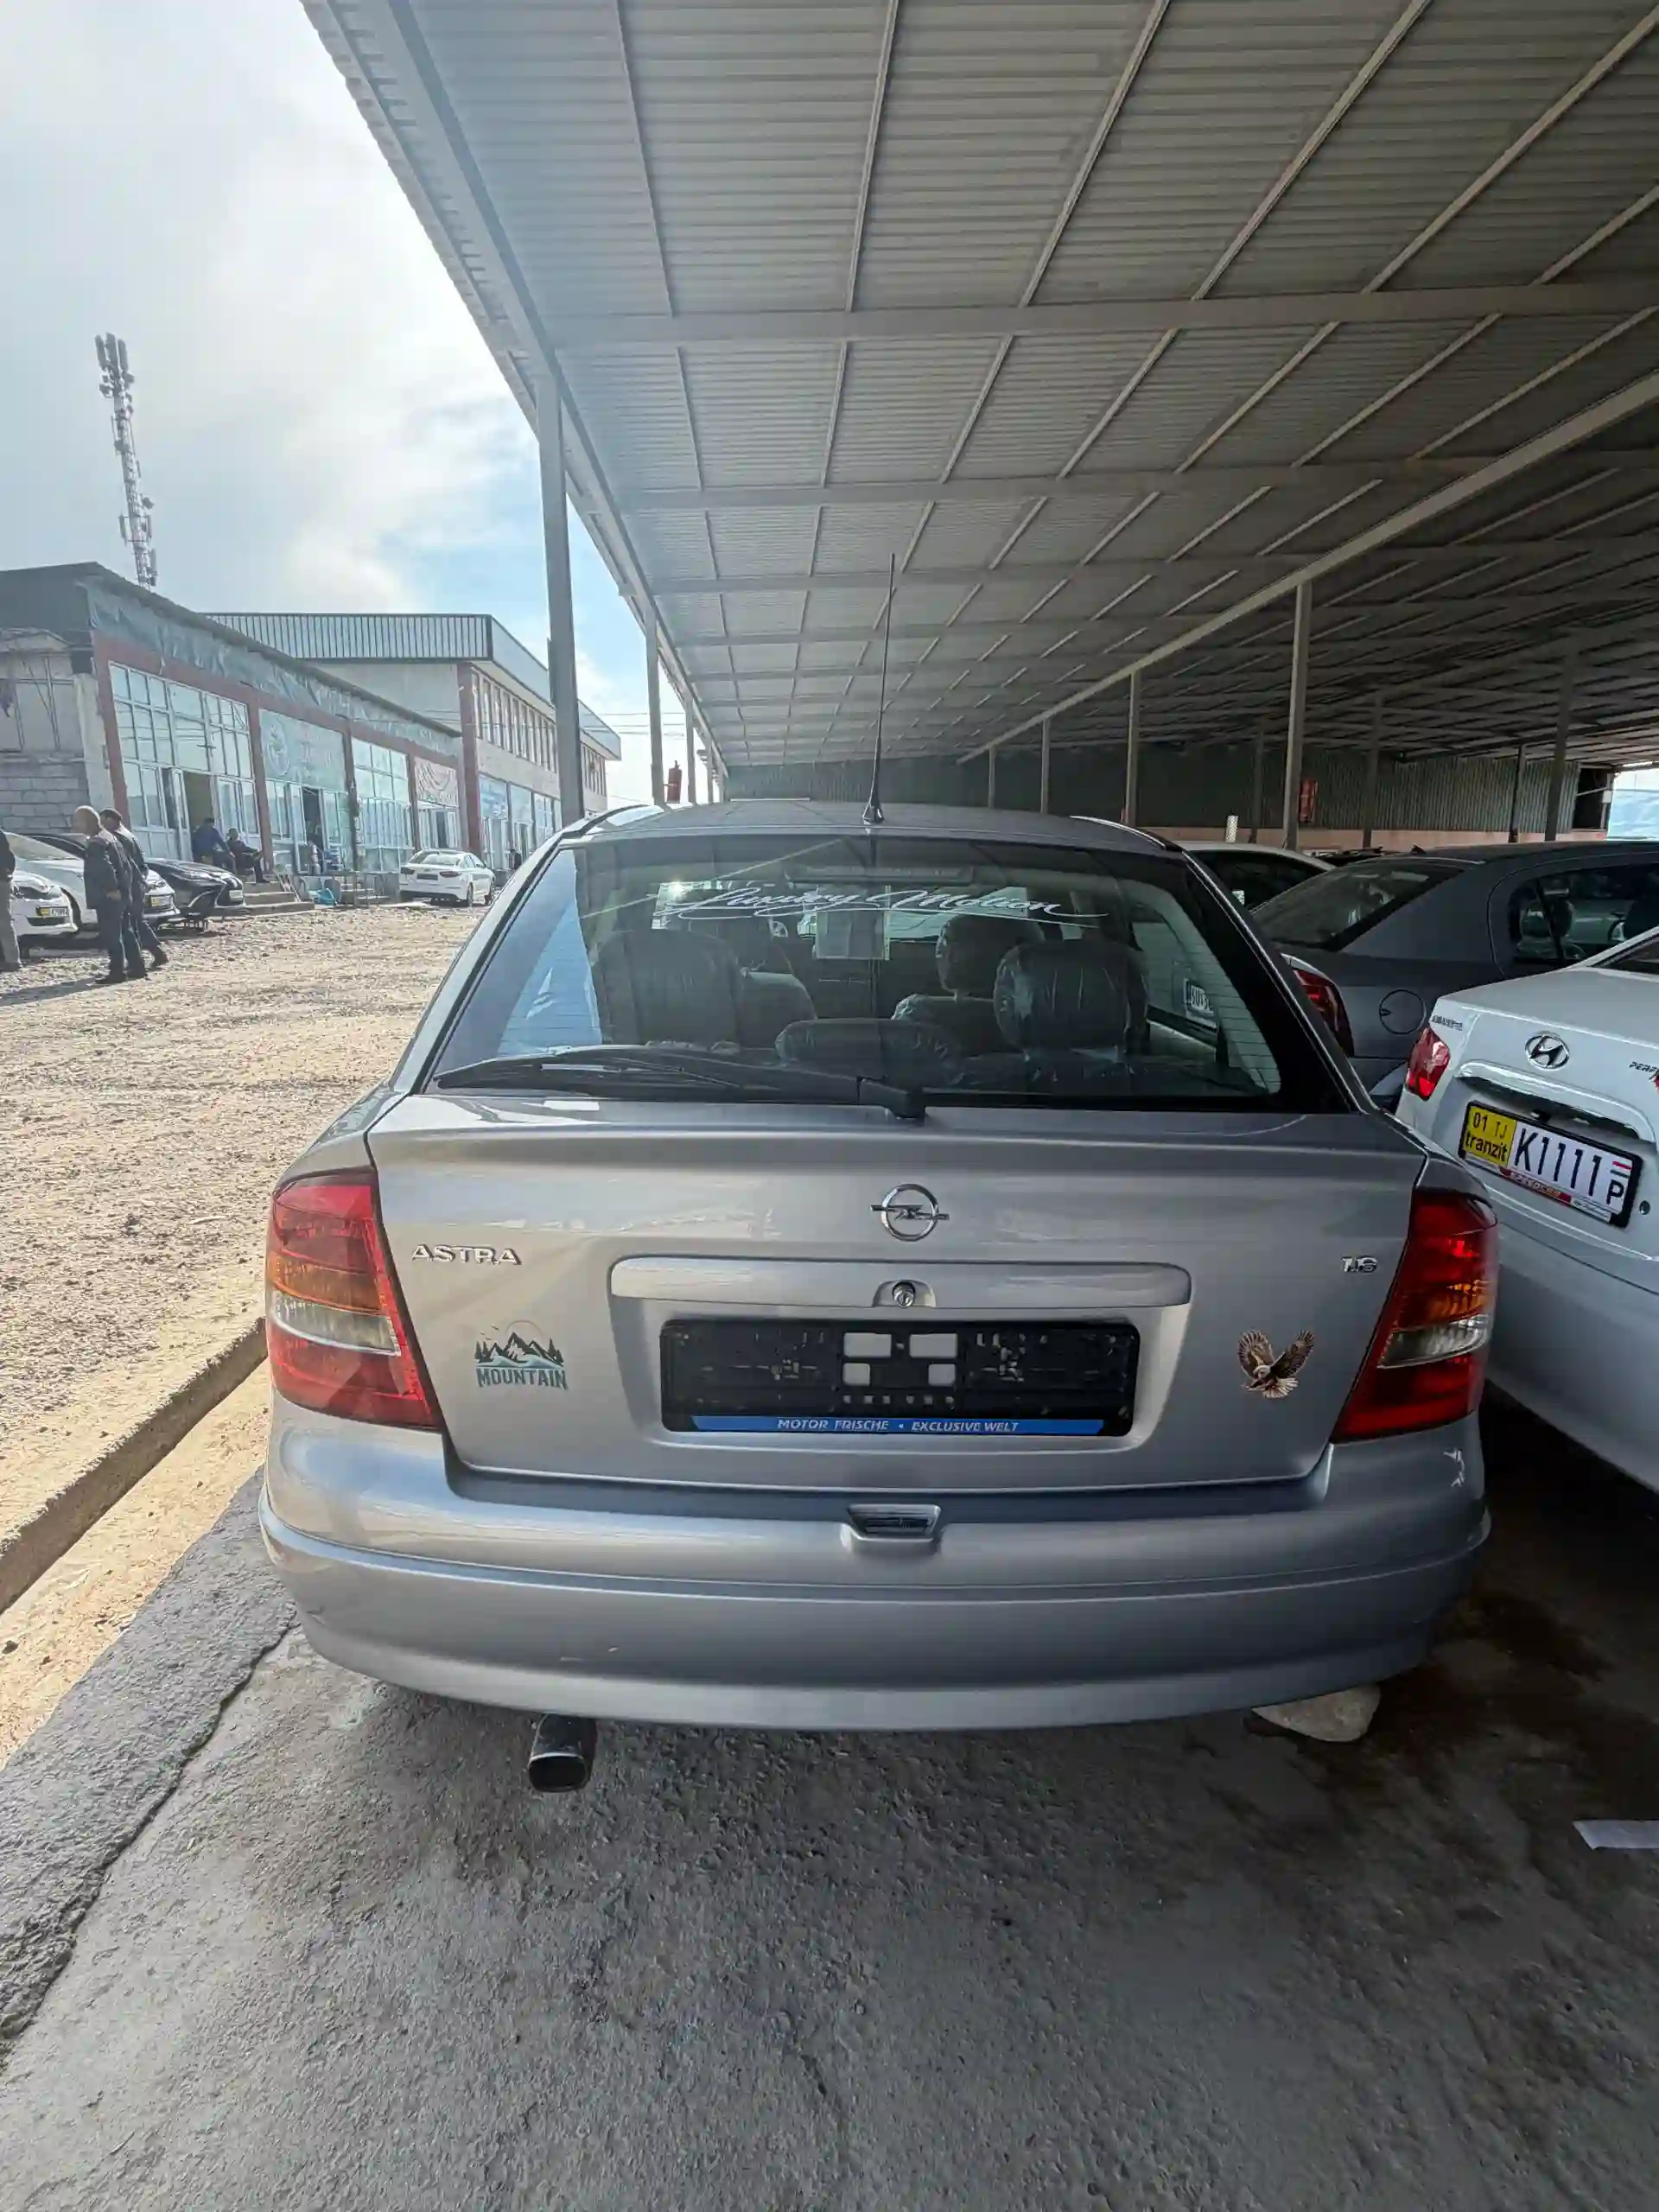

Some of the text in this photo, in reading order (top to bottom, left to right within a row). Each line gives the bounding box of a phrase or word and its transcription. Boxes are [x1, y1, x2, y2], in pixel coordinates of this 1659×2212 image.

[865, 889, 1109, 918] Motion
[1472, 1112, 1489, 1133] 01
[1465, 1129, 1508, 1162] tranzit
[1514, 1128, 1603, 1197] K1111
[1605, 1179, 1625, 1205] P
[410, 1243, 522, 1266] ASTRA
[476, 1368, 569, 1390] MOUNTAIN
[777, 1418, 1020, 1433] MOTOR FRISCHE EXCLUSIVE WELT
